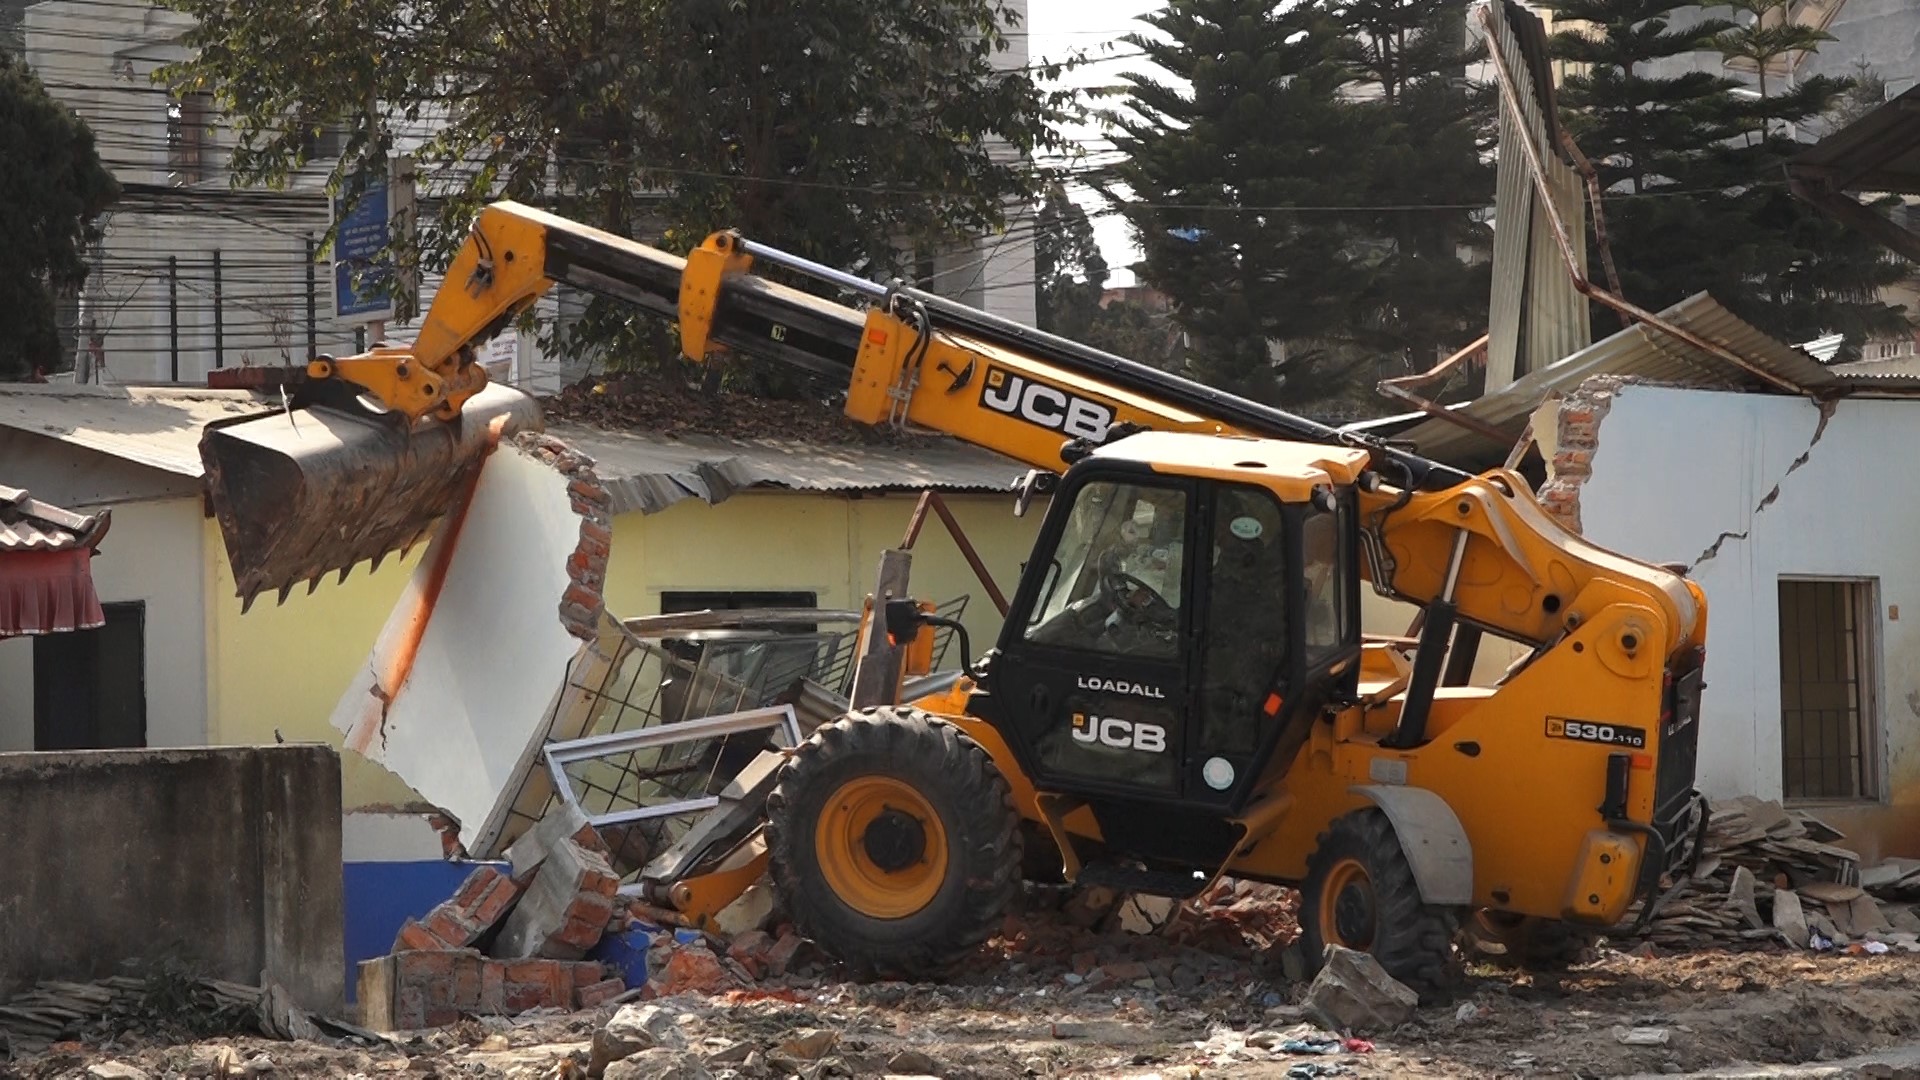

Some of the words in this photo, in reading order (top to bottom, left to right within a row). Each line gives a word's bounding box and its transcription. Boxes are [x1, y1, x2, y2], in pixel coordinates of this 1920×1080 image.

[984, 376, 1111, 443] JCB
[1078, 676, 1165, 698] LOADALL
[1072, 715, 1166, 752] JCB
